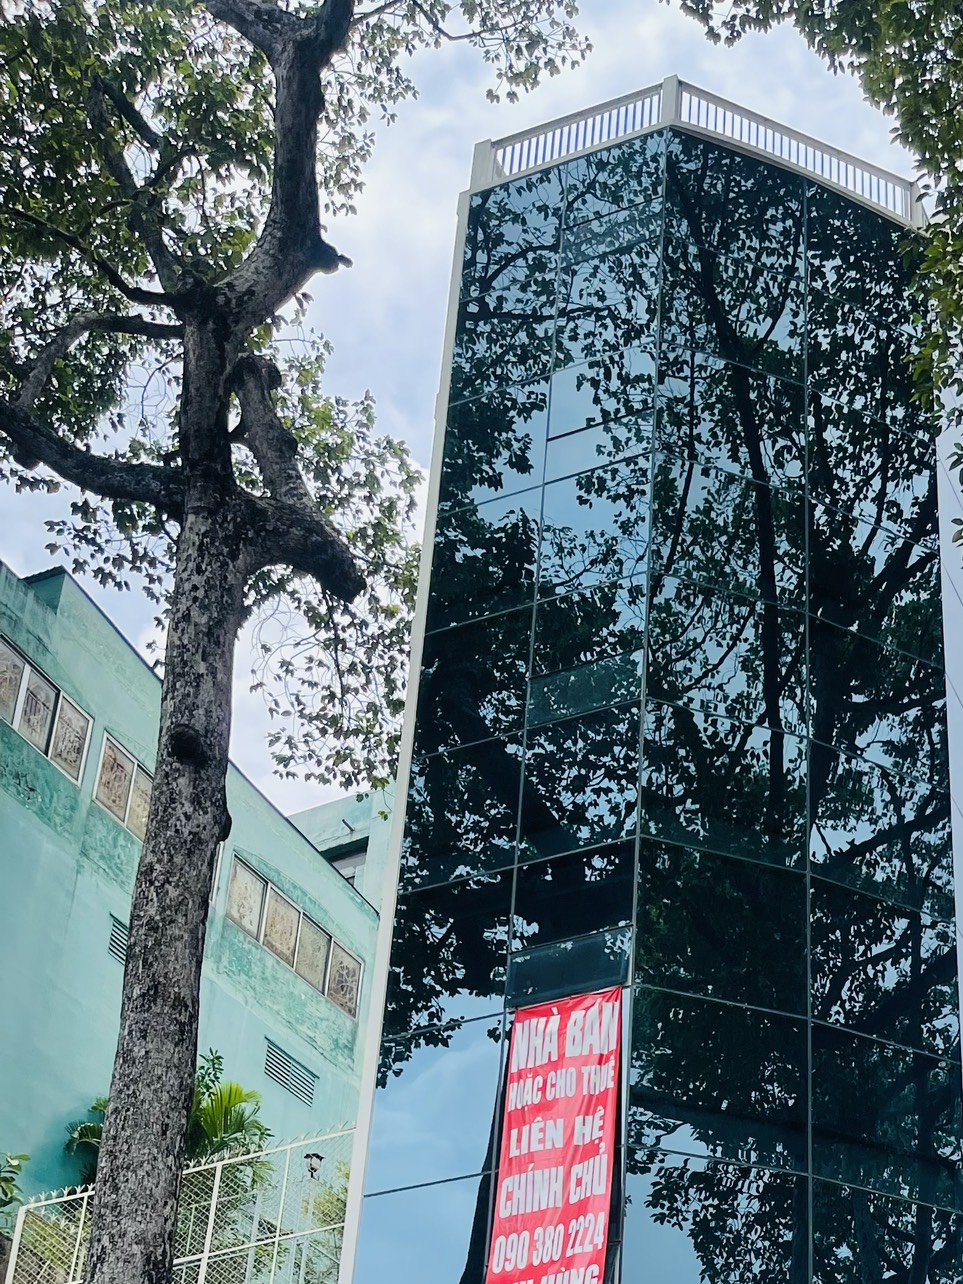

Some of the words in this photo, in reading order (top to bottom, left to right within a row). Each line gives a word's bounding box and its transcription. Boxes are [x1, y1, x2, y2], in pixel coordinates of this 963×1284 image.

[511, 1007, 560, 1073] NHÀ
[565, 998, 619, 1058] BÁN
[508, 1074, 543, 1112] HOẶC
[545, 1067, 577, 1101] CHO
[581, 1055, 615, 1096] THUÊ
[509, 1117, 564, 1158] LIÊN
[574, 1105, 605, 1145] HỆ
[499, 1163, 565, 1218] CHÍNH
[569, 1143, 608, 1205] CHỦ
[492, 1230, 530, 1274] 090
[532, 1223, 565, 1266] 380
[565, 1212, 605, 1258] 2224
